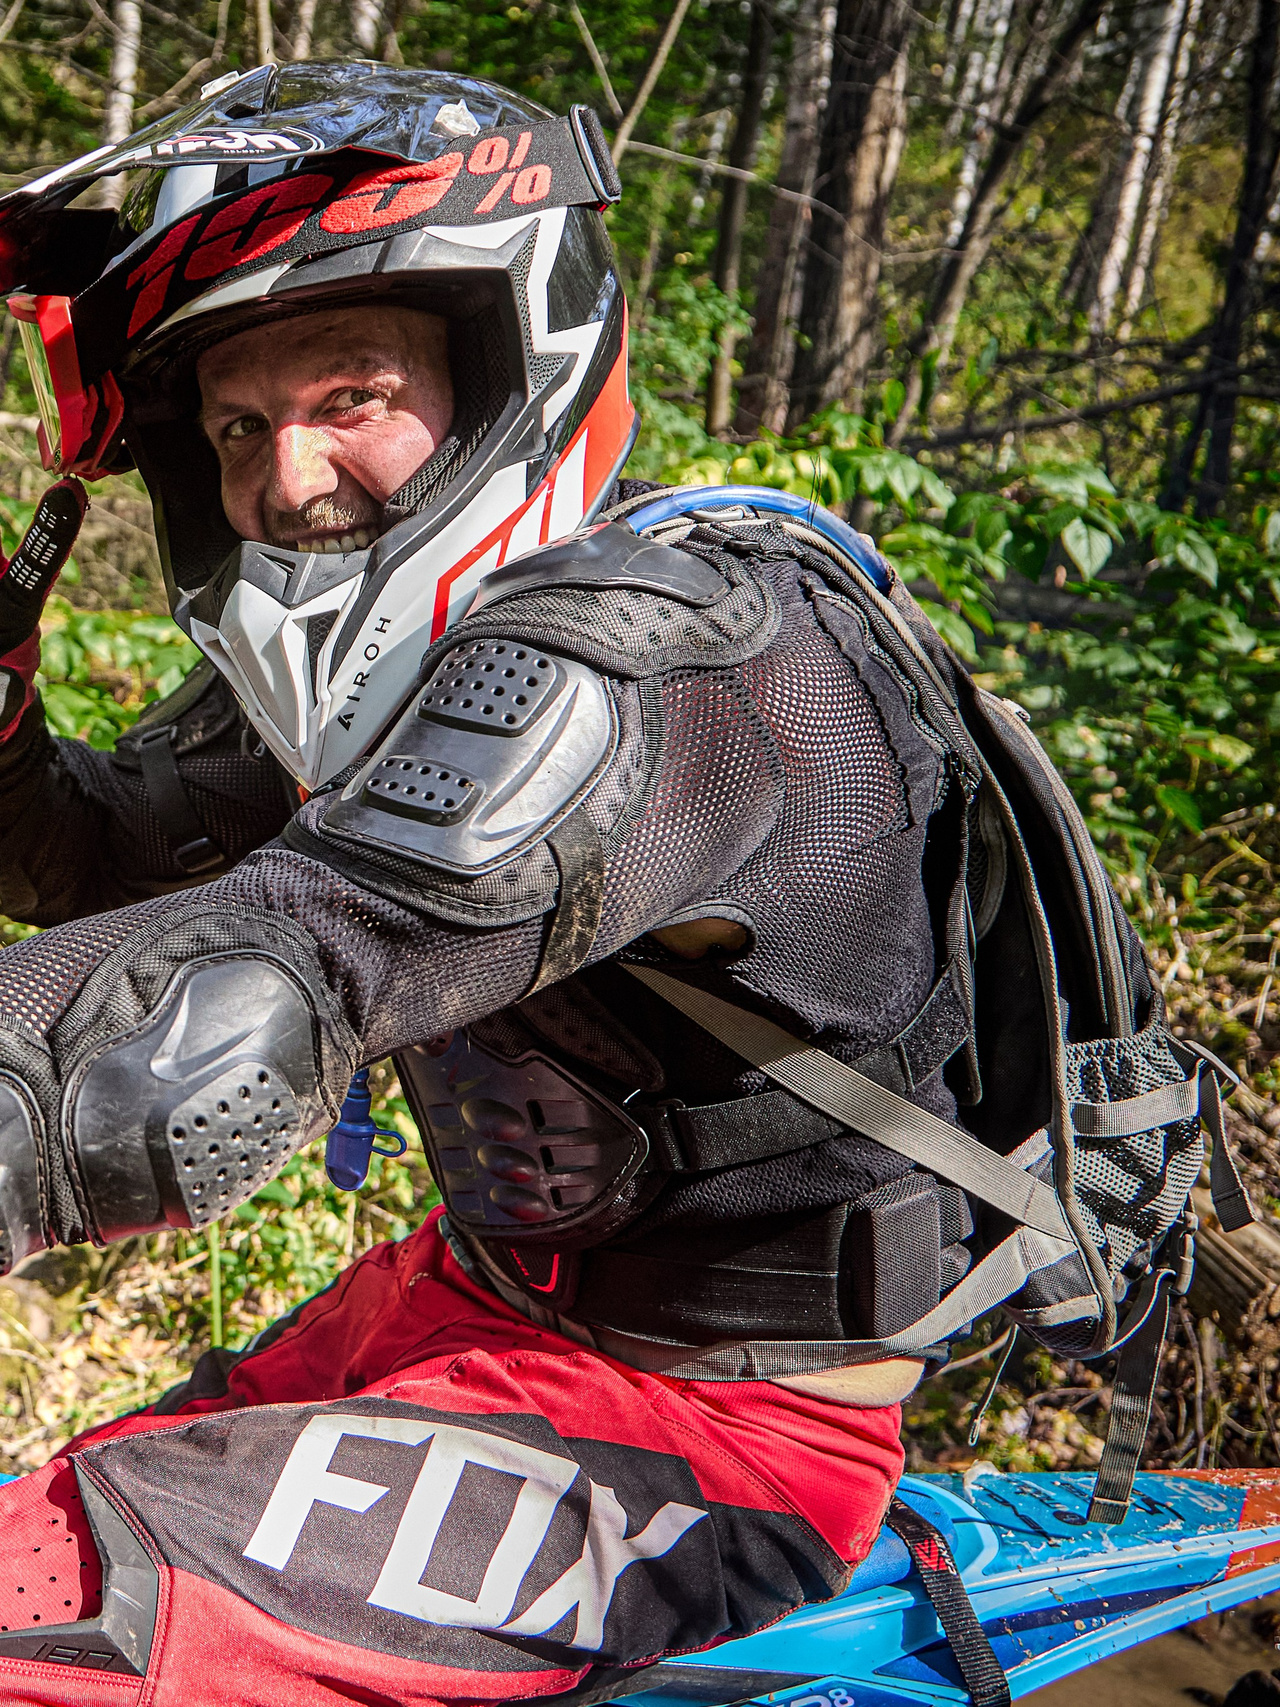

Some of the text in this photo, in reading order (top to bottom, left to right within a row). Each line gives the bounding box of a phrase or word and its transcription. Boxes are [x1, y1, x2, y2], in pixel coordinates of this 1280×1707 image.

[124, 130, 553, 340] 100%
[336, 616, 392, 732] AIROH
[241, 1414, 710, 1653] FOX
